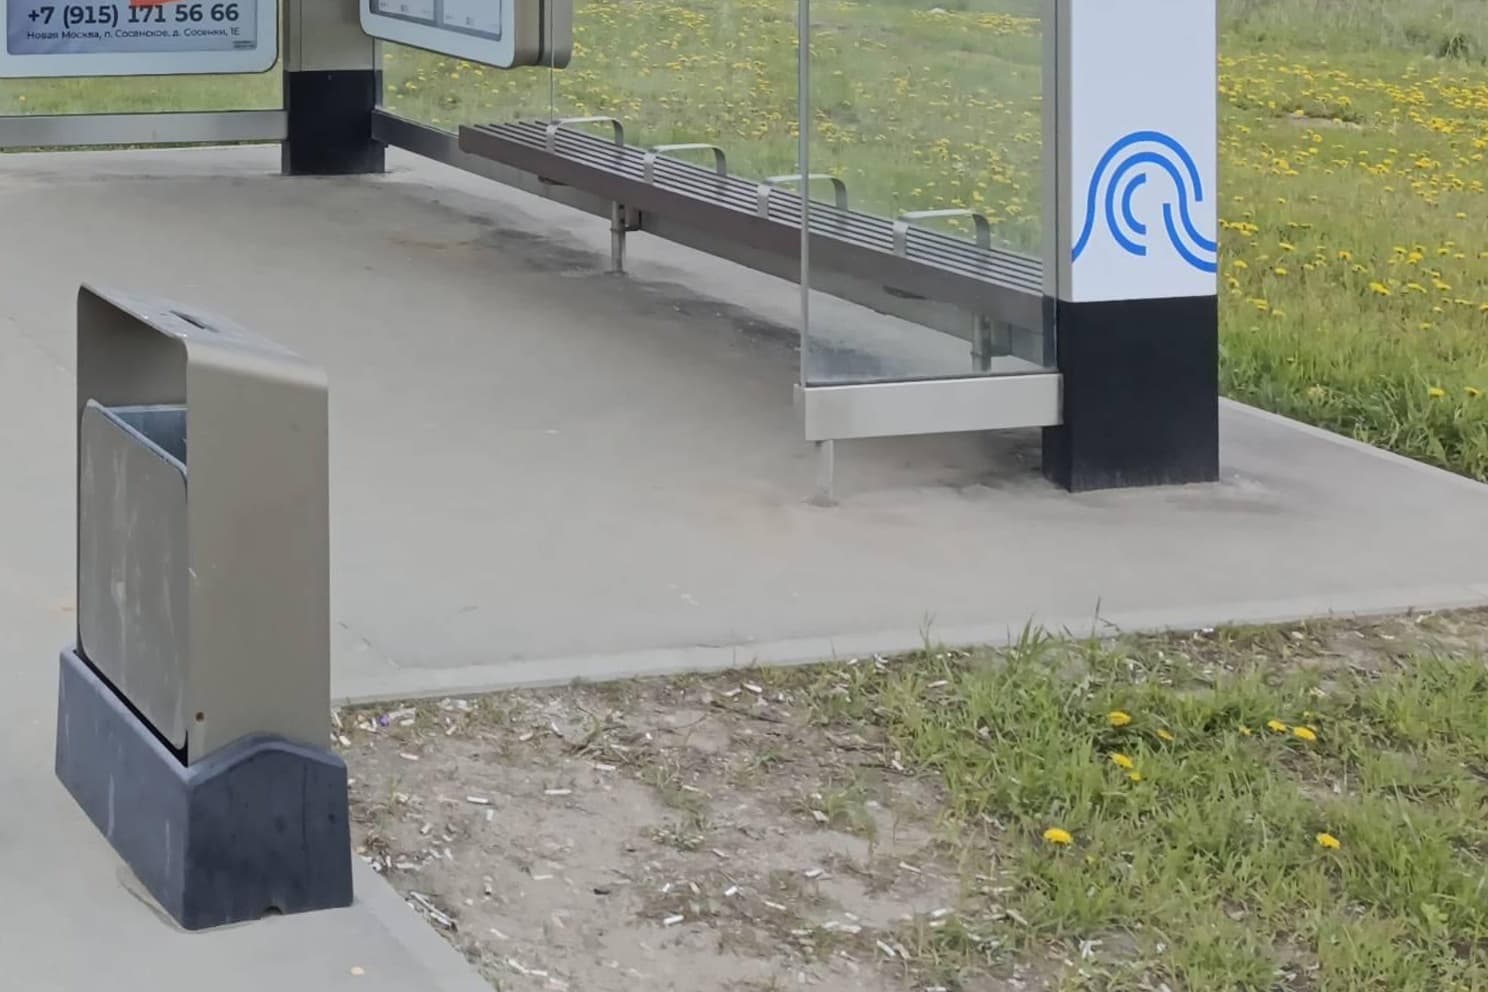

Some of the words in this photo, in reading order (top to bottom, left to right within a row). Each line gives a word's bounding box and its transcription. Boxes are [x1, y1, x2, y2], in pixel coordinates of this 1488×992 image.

[28, 6, 56, 24] +7
[63, 5, 119, 29] (915)
[128, 5, 166, 23] 171
[175, 4, 203, 22] 56
[210, 3, 239, 21] 66
